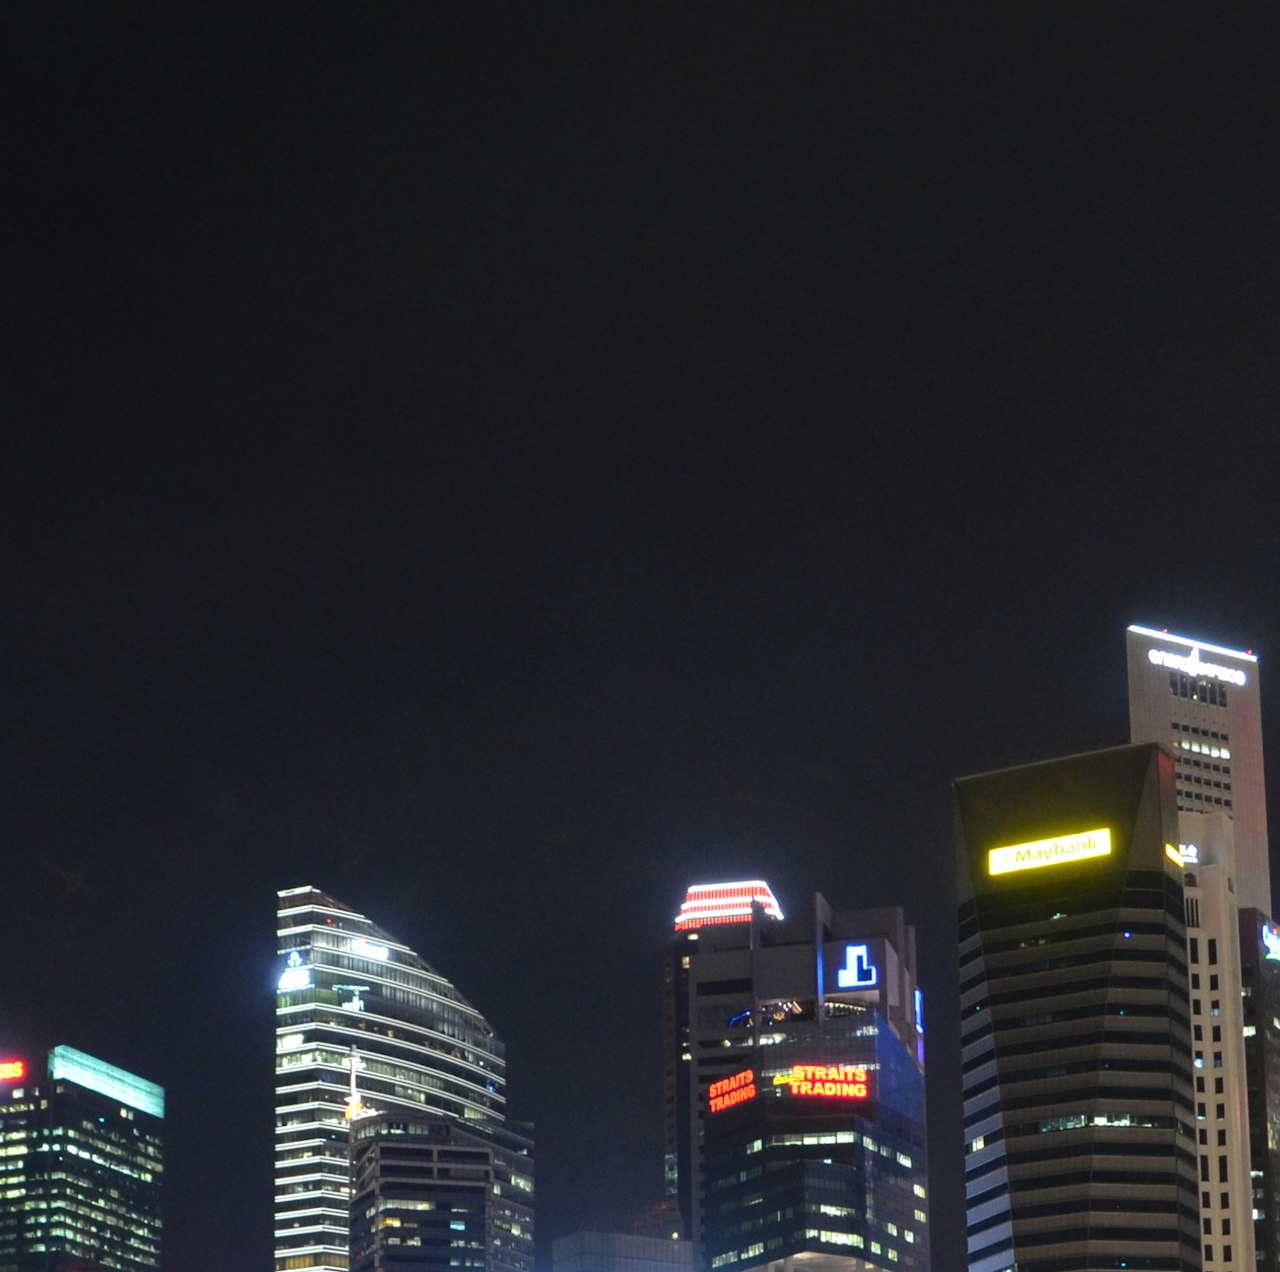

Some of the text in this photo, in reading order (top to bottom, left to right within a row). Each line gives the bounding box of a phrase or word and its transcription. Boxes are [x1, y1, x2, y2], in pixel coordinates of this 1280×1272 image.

[1015, 836, 1099, 864] Maybank
[709, 1069, 754, 1099] STRAITS
[791, 1065, 866, 1082] STRAITS
[709, 1084, 756, 1113] TRADING
[790, 1081, 867, 1098] TRADING
